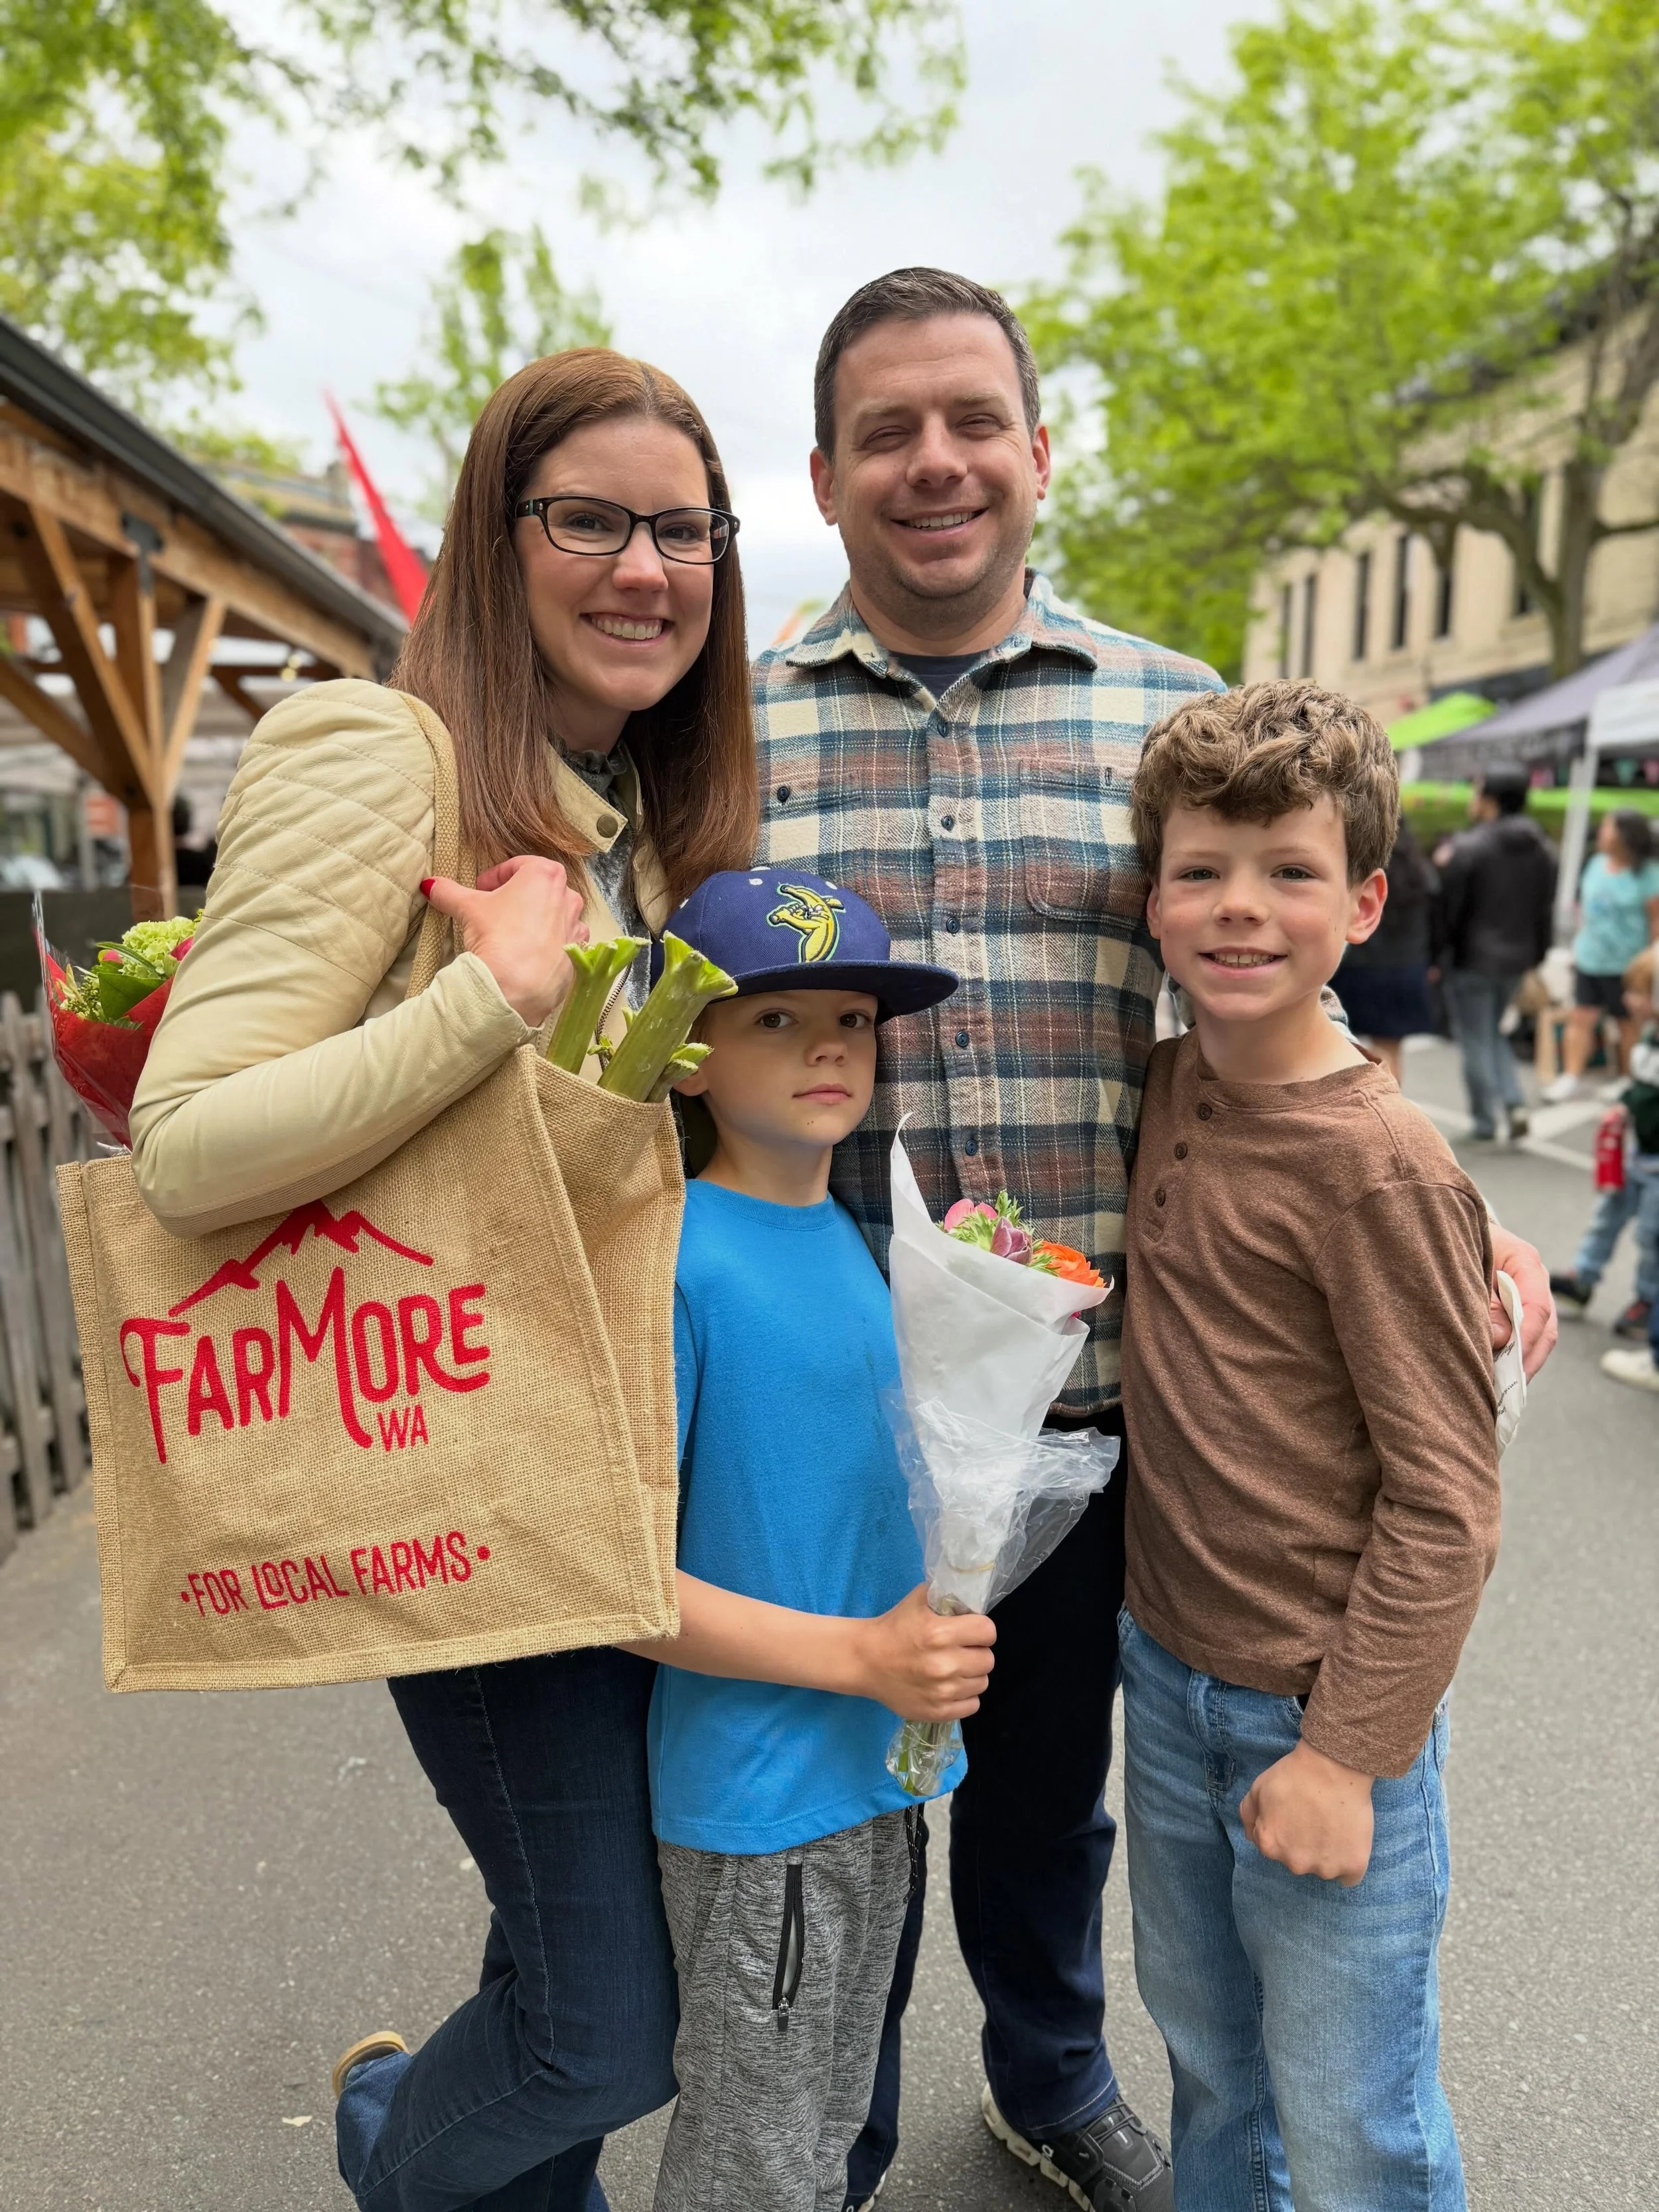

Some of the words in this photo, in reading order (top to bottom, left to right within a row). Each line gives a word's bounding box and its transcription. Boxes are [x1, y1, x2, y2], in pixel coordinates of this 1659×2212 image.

[376, 1404, 429, 1453] WA
[187, 1569, 250, 1617] FOR
[251, 1554, 350, 1611] LOCAL
[350, 1530, 472, 1594] FARMS
